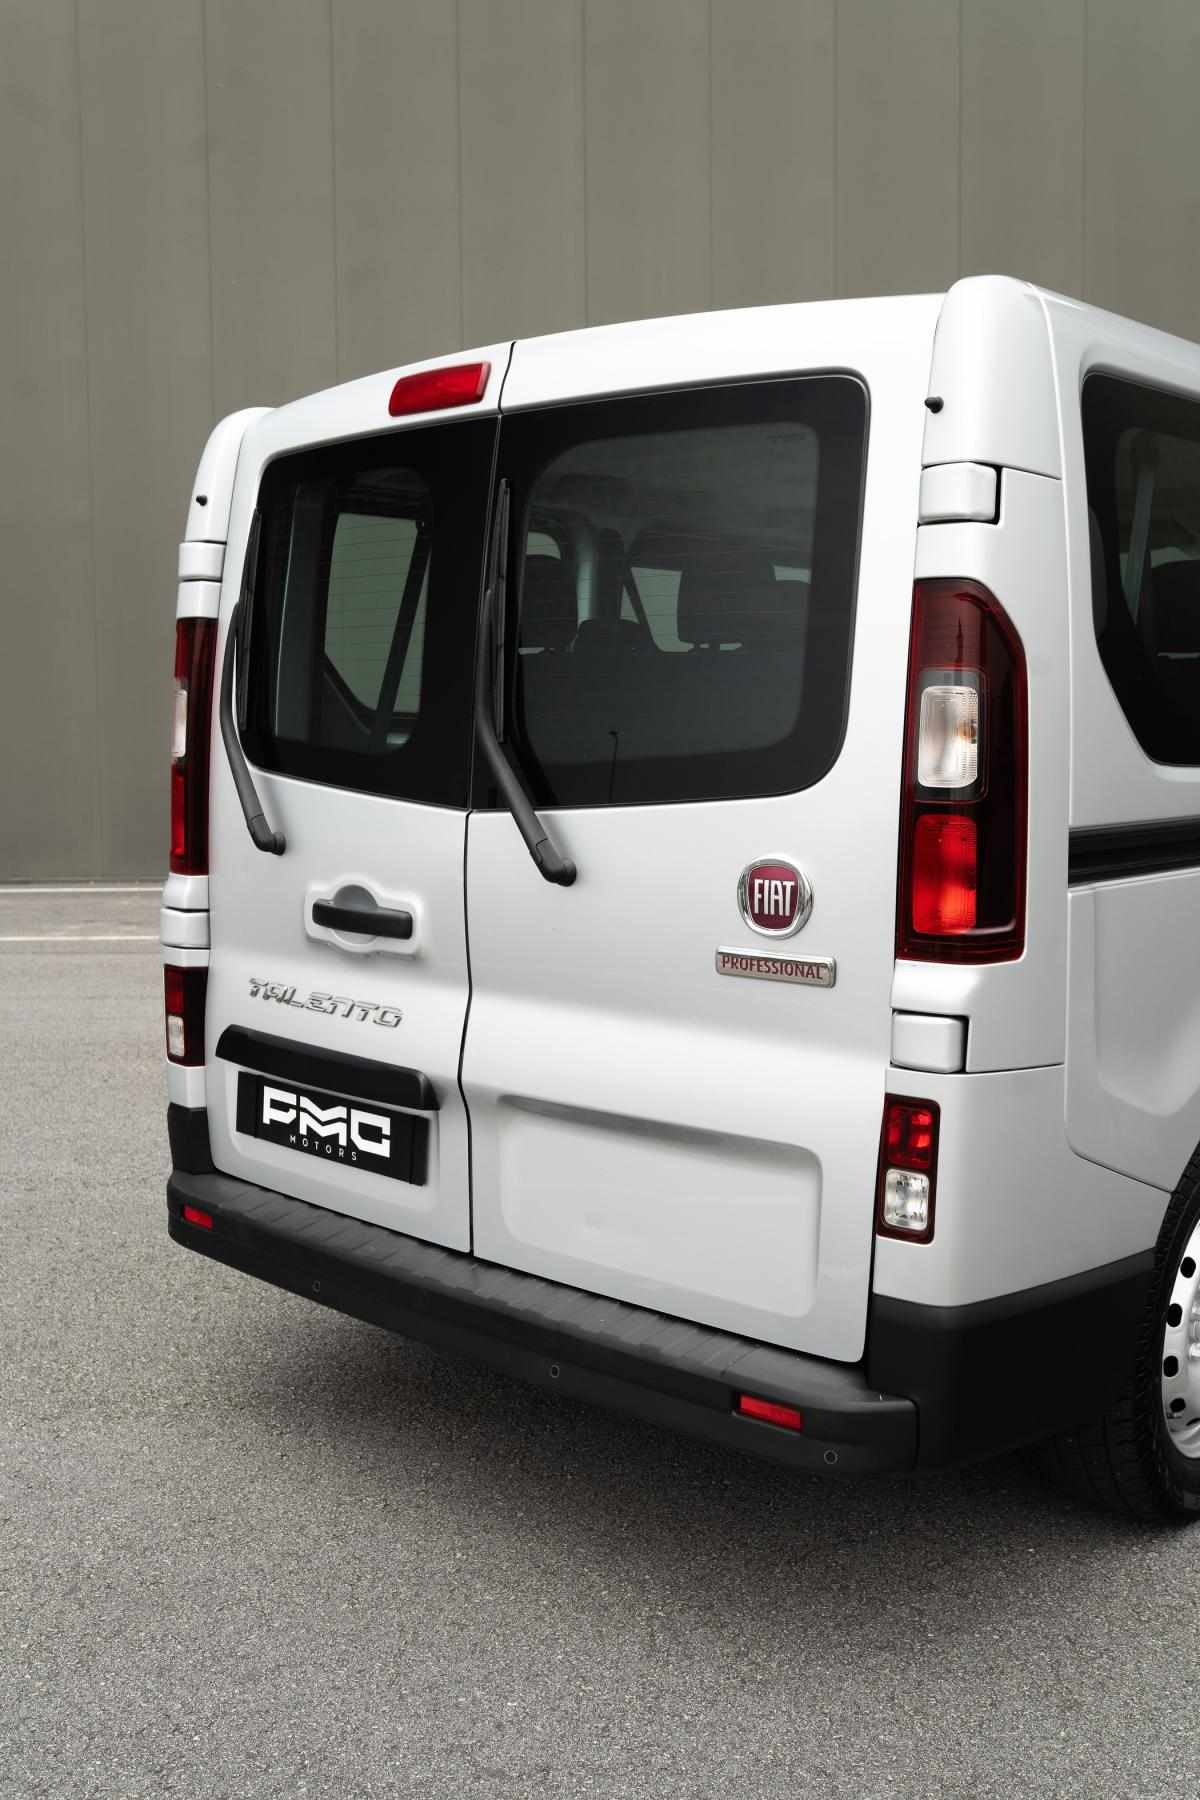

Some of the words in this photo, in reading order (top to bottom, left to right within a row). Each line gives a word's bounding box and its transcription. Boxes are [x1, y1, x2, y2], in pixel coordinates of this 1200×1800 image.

[754, 879, 795, 917] FIAT
[721, 955, 823, 980] PROFESSIONAL
[248, 978, 403, 1028] TALENTO
[262, 1085, 391, 1158] PMC
[289, 1135, 357, 1161] MOTORS
